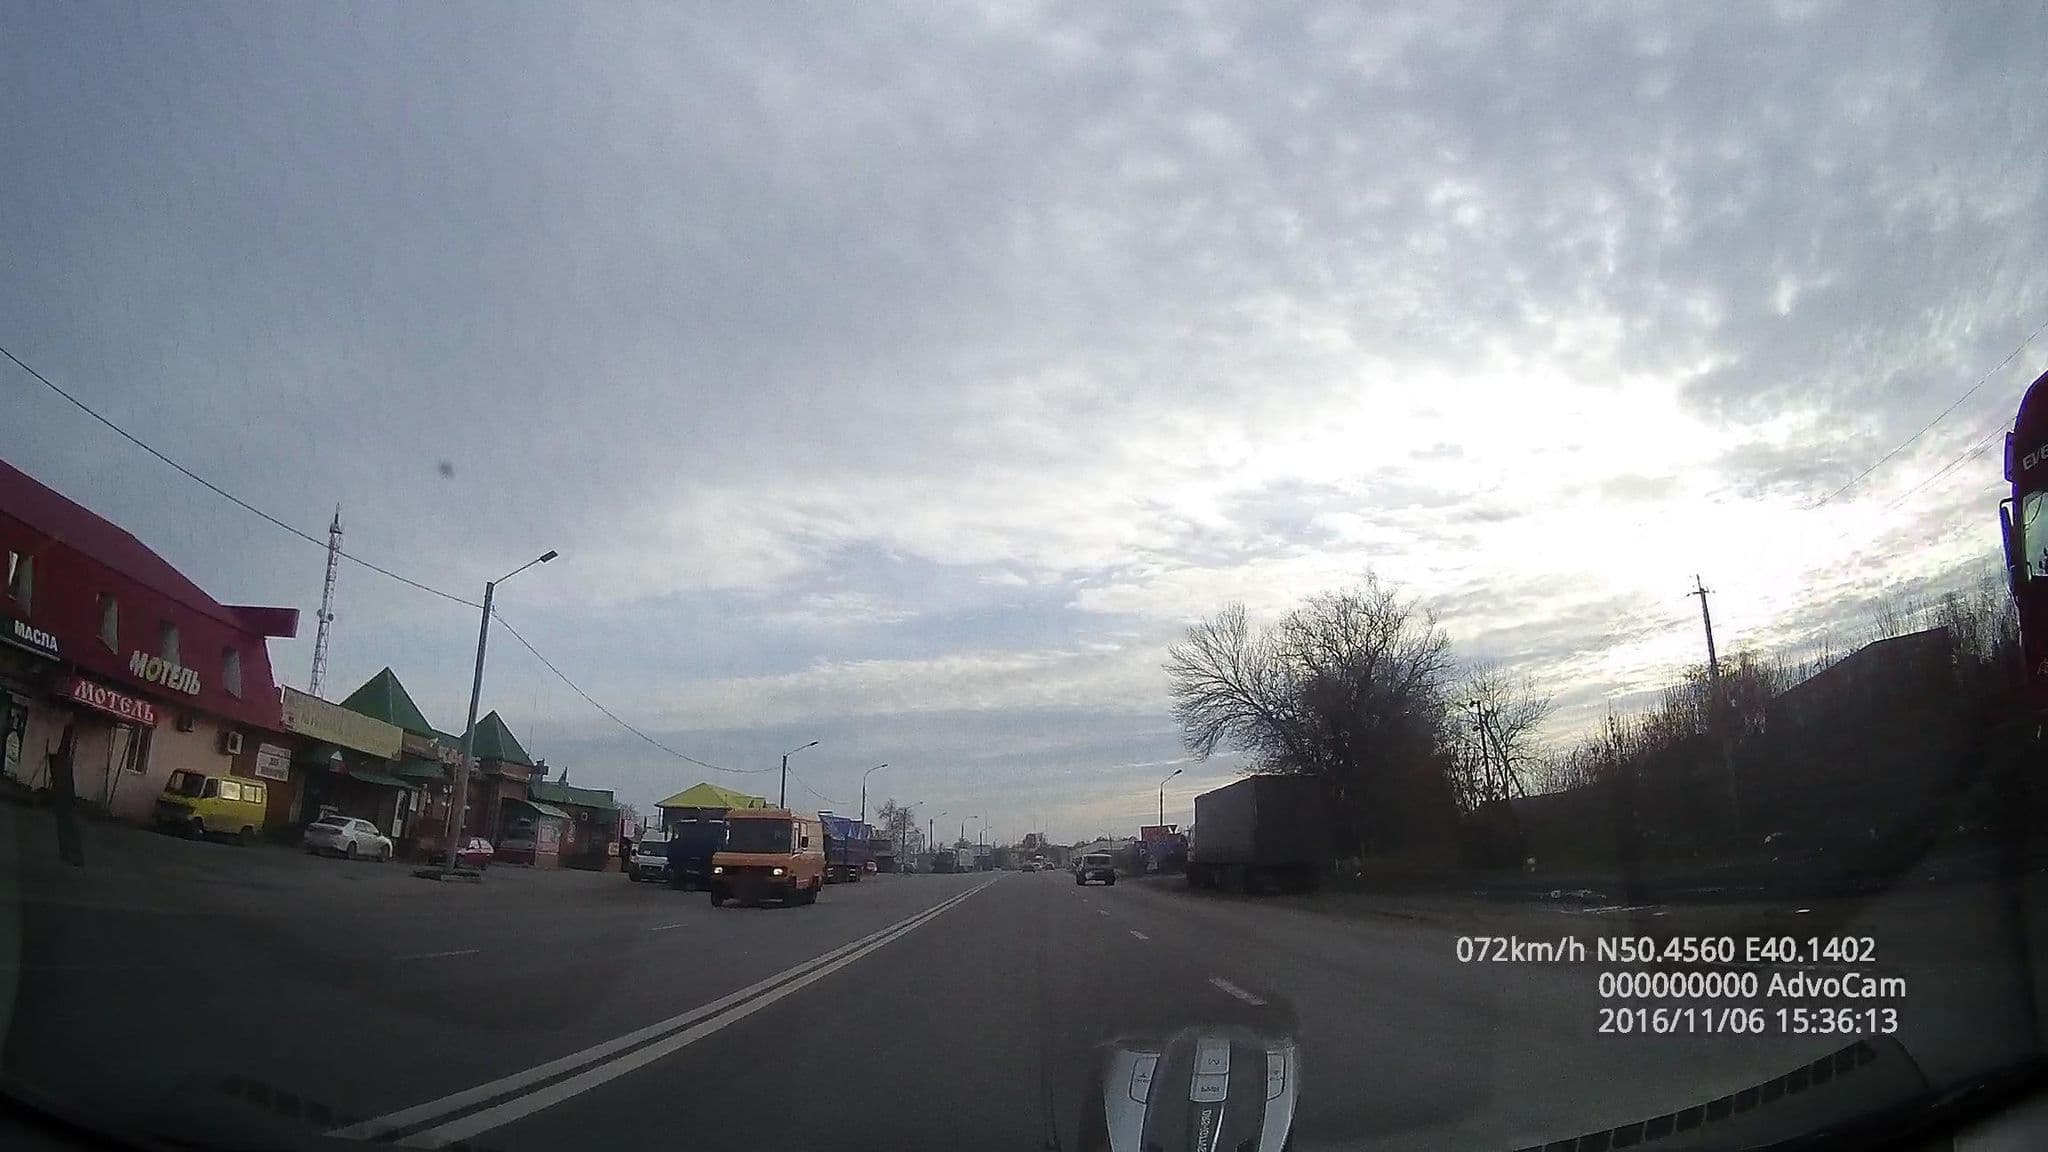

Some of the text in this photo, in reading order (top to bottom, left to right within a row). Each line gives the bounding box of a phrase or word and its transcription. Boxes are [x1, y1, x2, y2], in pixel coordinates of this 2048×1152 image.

[14, 619, 59, 652] МАСЛА
[129, 650, 201, 696] МОТЕЛЬ
[74, 680, 155, 720] МОТЕЛЬ
